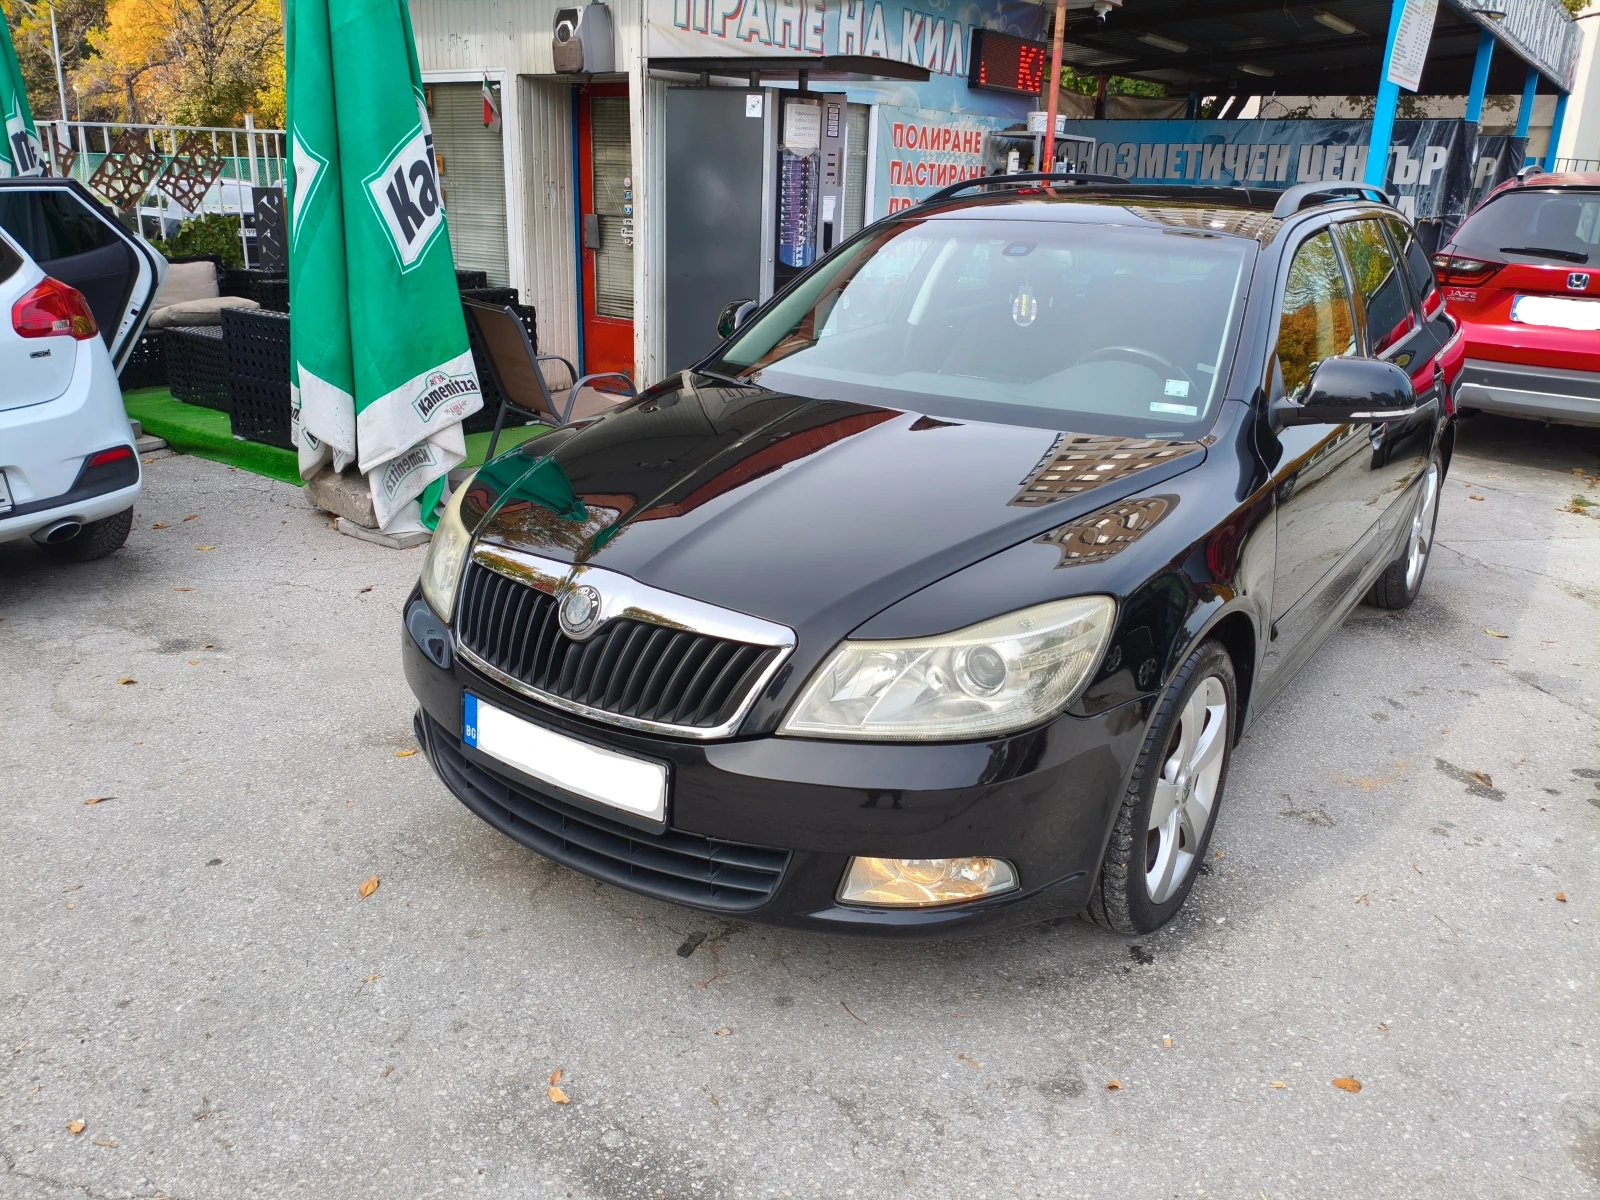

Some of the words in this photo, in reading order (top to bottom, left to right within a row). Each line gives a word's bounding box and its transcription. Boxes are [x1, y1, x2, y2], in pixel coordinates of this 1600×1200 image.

[838, 0, 888, 58] НА
[892, 122, 982, 154] ПОЛИРАНЕ
[890, 160, 987, 188] ПАСТИРАНЕ
[1297, 144, 1447, 186] ЦЕНЪР
[1020, 294, 1028, 316] areon
[1447, 290, 1477, 299] JAZZ
[417, 377, 479, 417] Kamenitza
[466, 725, 476, 739] BG
